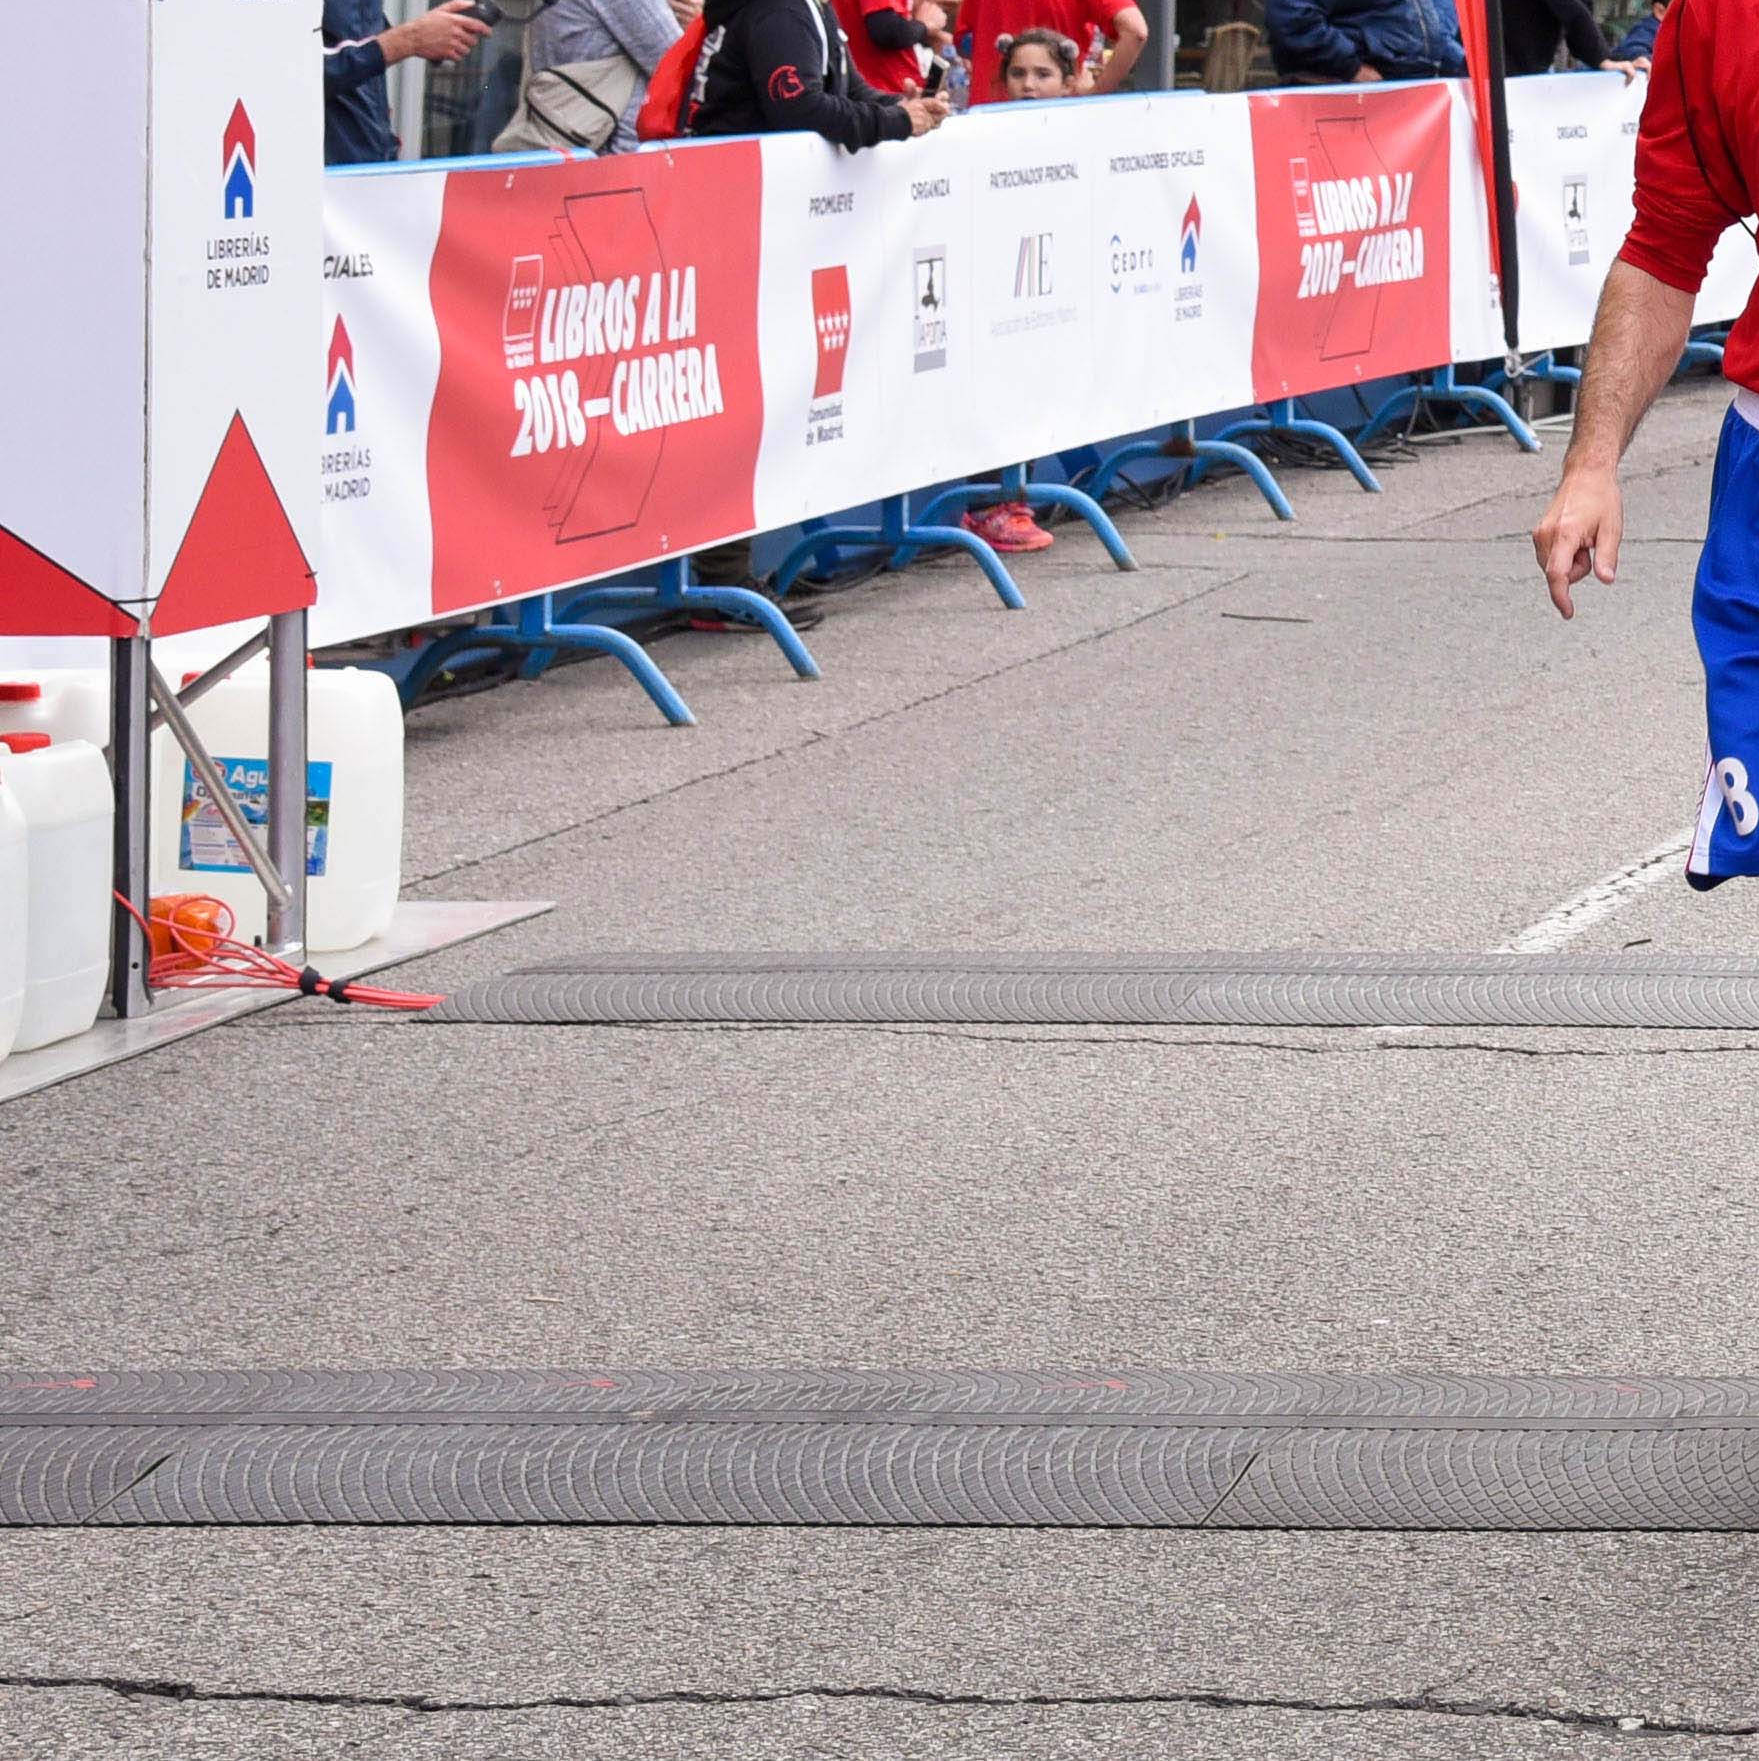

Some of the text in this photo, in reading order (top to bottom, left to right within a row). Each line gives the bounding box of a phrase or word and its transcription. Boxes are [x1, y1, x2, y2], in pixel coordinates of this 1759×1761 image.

[1312, 176, 1378, 235] LIBROS
[206, 232, 270, 261] LIBRERÍAS
[206, 265, 270, 289] DE MADRID
[540, 265, 696, 364] LIBROS A LA
